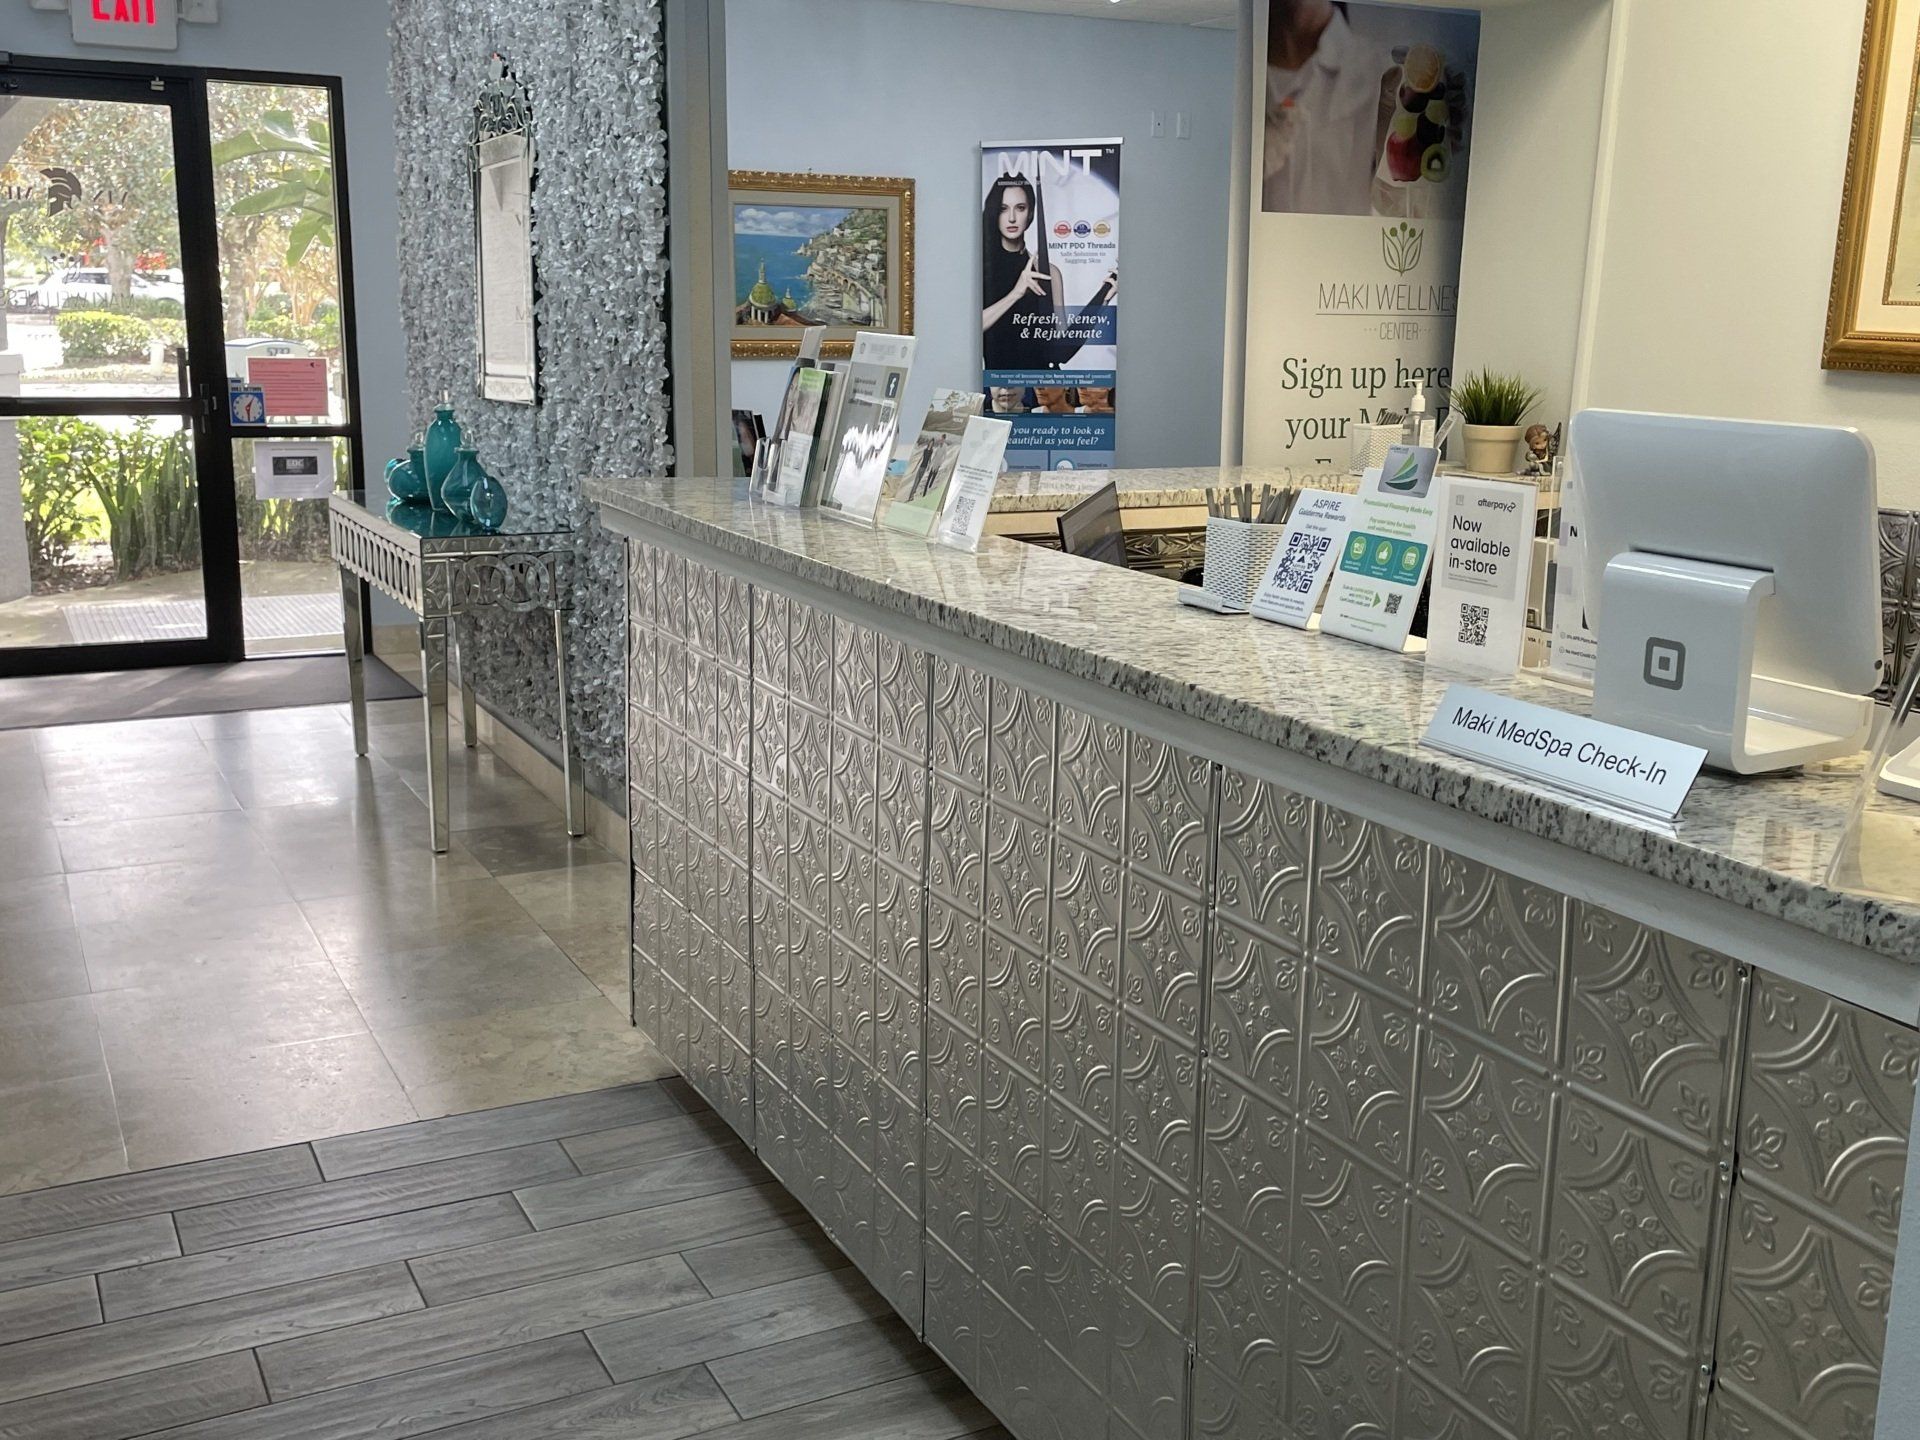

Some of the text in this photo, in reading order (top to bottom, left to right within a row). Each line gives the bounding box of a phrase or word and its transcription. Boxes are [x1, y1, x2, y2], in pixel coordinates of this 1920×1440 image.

[999, 149, 1102, 178] MINT
[1318, 283, 1369, 310] MAKI
[1012, 313, 1111, 327] Refresh, Renew,
[1020, 328, 1103, 341] & Rejuvenate
[1379, 322, 1418, 341] CENTER
[1281, 357, 1450, 399] Sign up here
[1013, 427, 1030, 436] you
[1032, 426, 1059, 436] ready
[1061, 427, 1070, 435] to
[1073, 426, 1092, 435] look
[1285, 416, 1350, 449] your
[1008, 436, 1043, 446] eautiful
[1057, 438, 1075, 447] you
[1077, 436, 1099, 446] feel?
[1312, 499, 1341, 512] ASPIRE
[1477, 498, 1508, 512] afterpay
[1452, 514, 1482, 533] Now
[1450, 537, 1511, 557] available
[1448, 552, 1498, 575] in-store
[1452, 706, 1667, 785] Maki MedSpa Check-In
